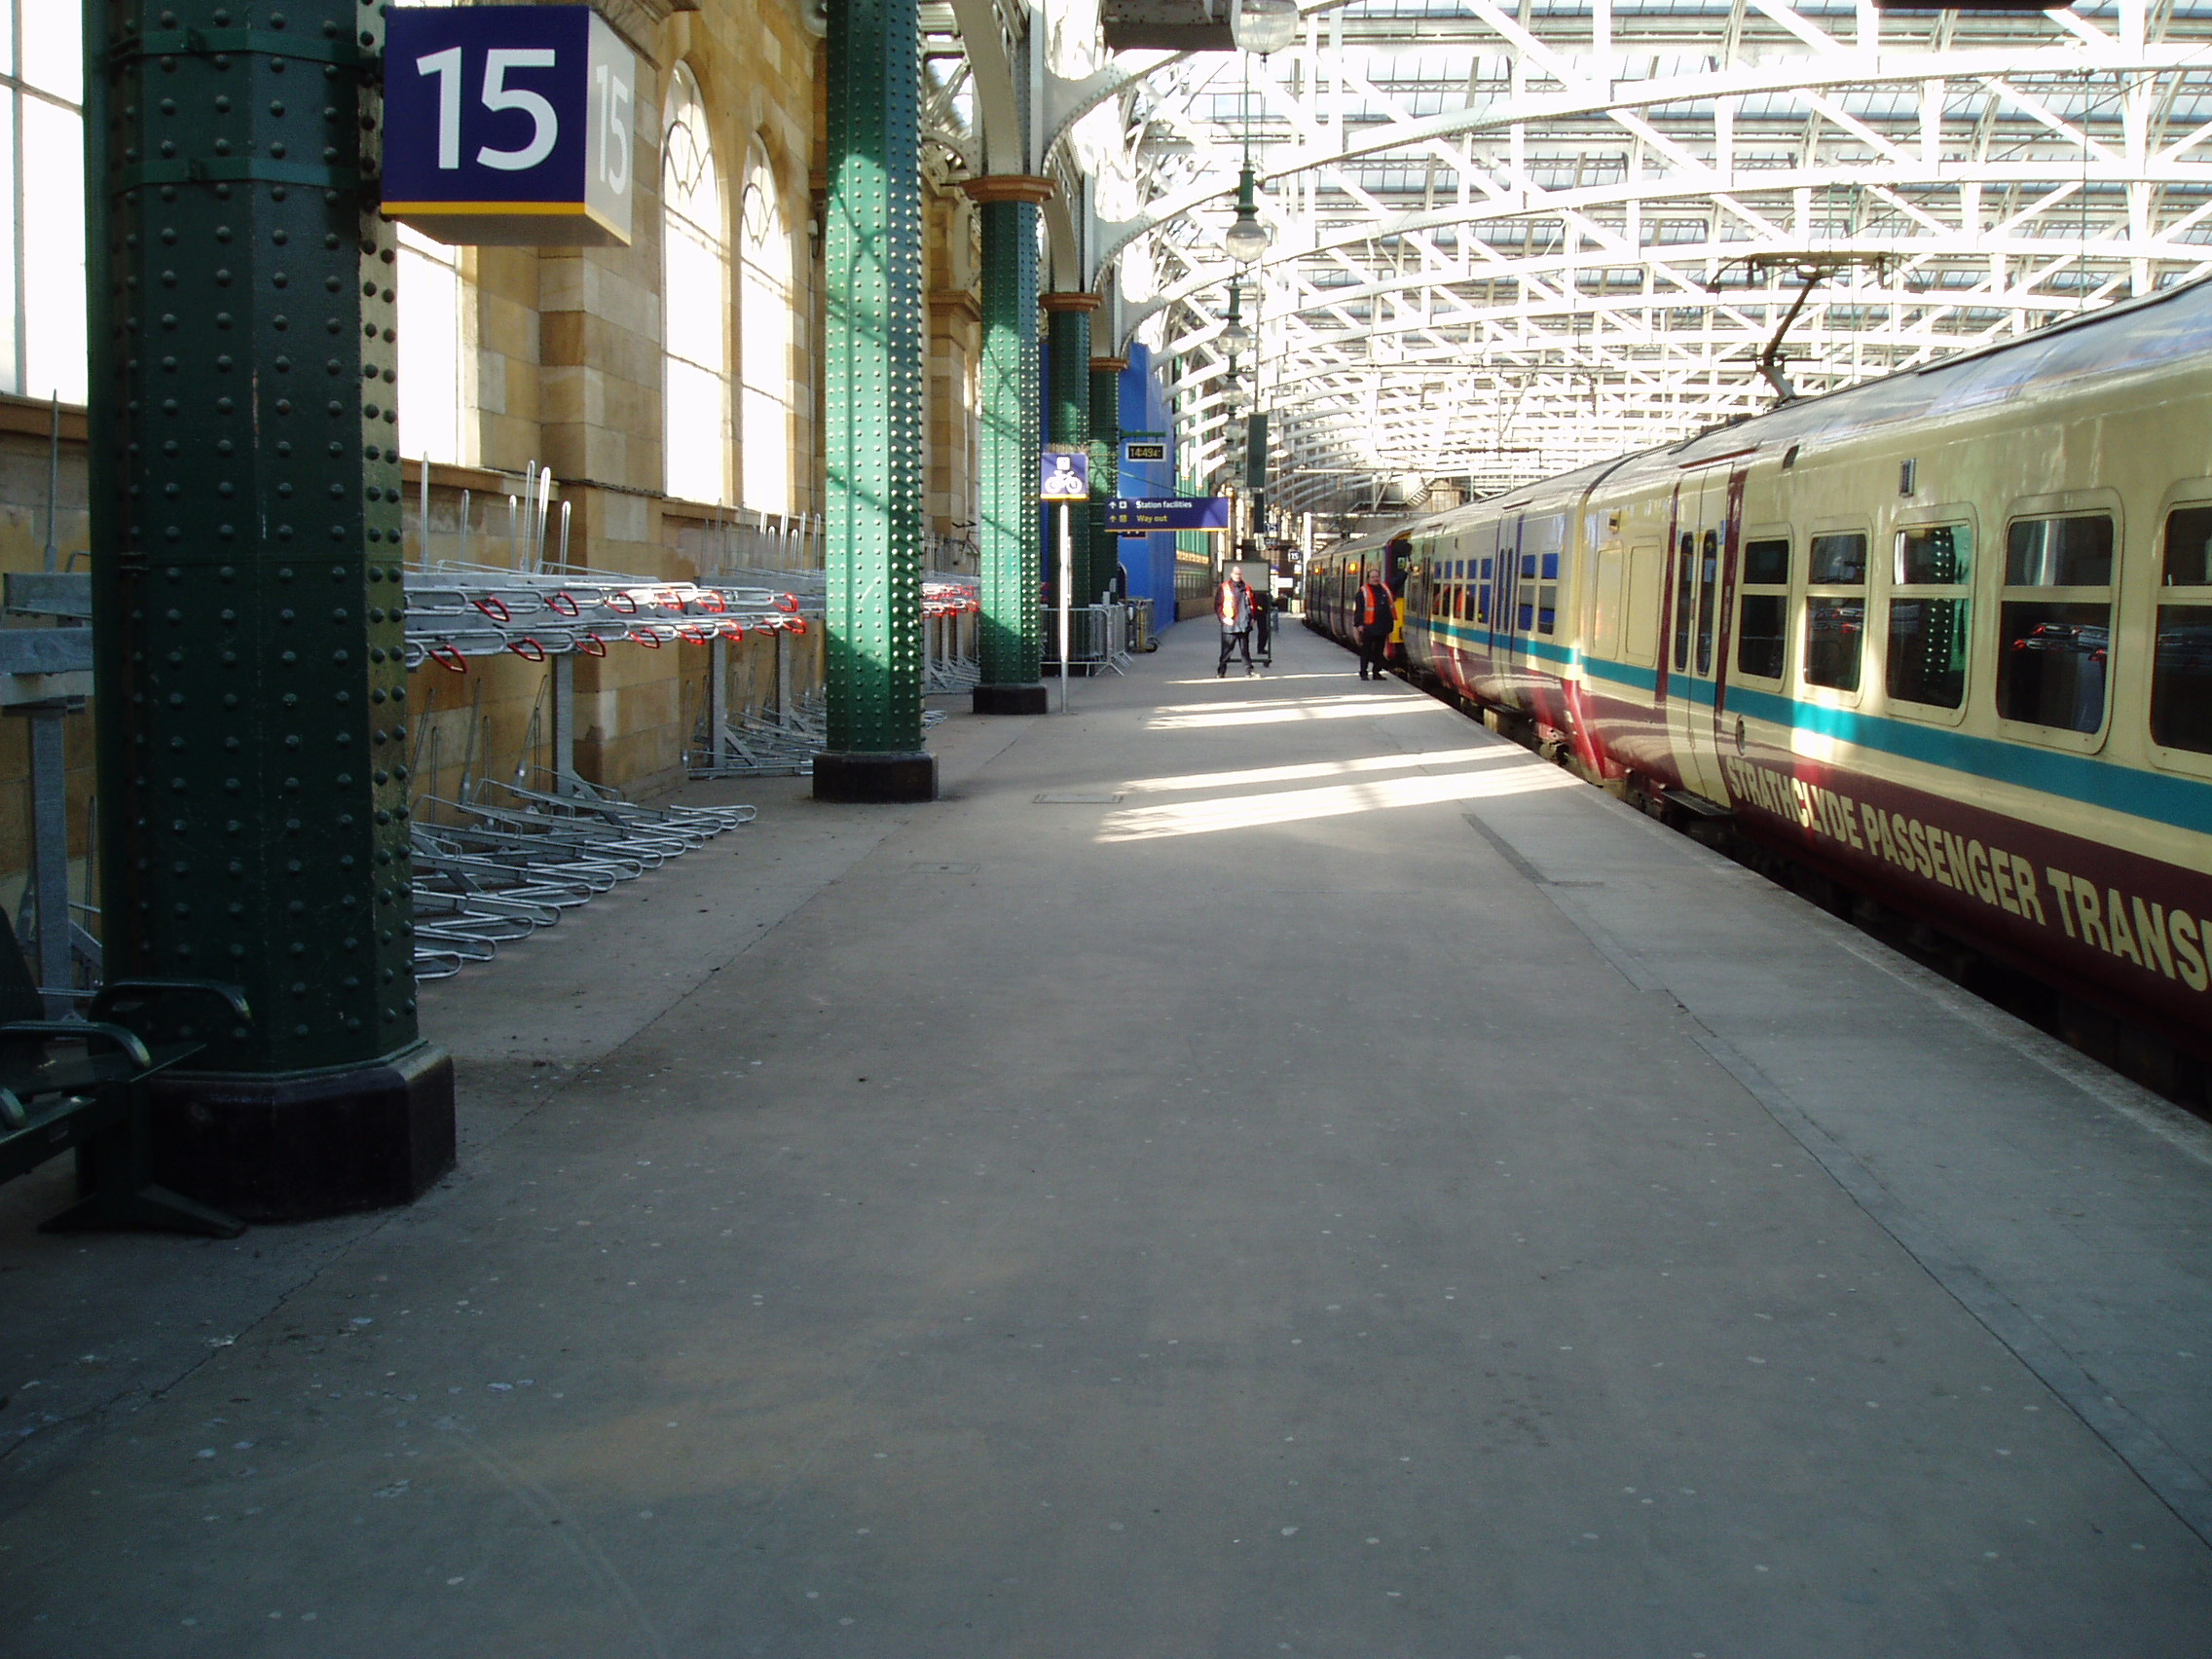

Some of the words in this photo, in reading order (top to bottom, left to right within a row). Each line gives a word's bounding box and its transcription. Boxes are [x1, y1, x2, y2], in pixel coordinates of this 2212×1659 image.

[416, 47, 558, 170] 15
[596, 64, 627, 195] 15
[1136, 514, 1152, 524] Way
[1727, 756, 1862, 849] STRATHCLYDE
[1861, 802, 2046, 925] PASSENGER
